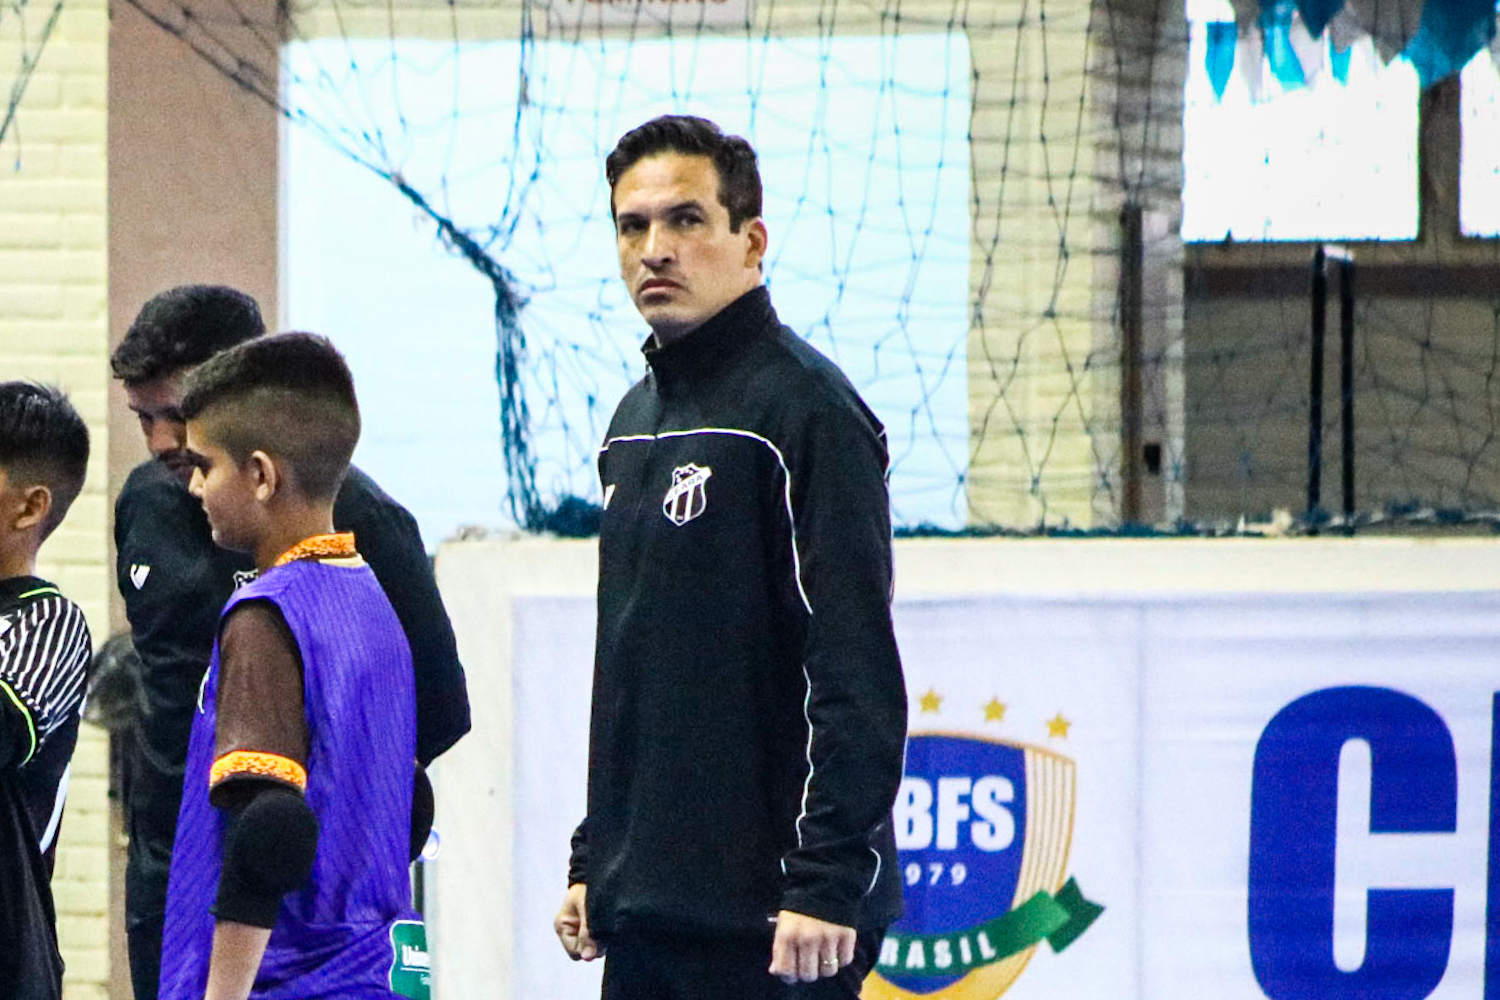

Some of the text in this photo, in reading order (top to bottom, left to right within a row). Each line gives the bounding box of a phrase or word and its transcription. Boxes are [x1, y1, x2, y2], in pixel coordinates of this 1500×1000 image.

[893, 775, 1015, 852] BFS
[905, 862, 967, 886] 979
[878, 930, 996, 968] RASIL
